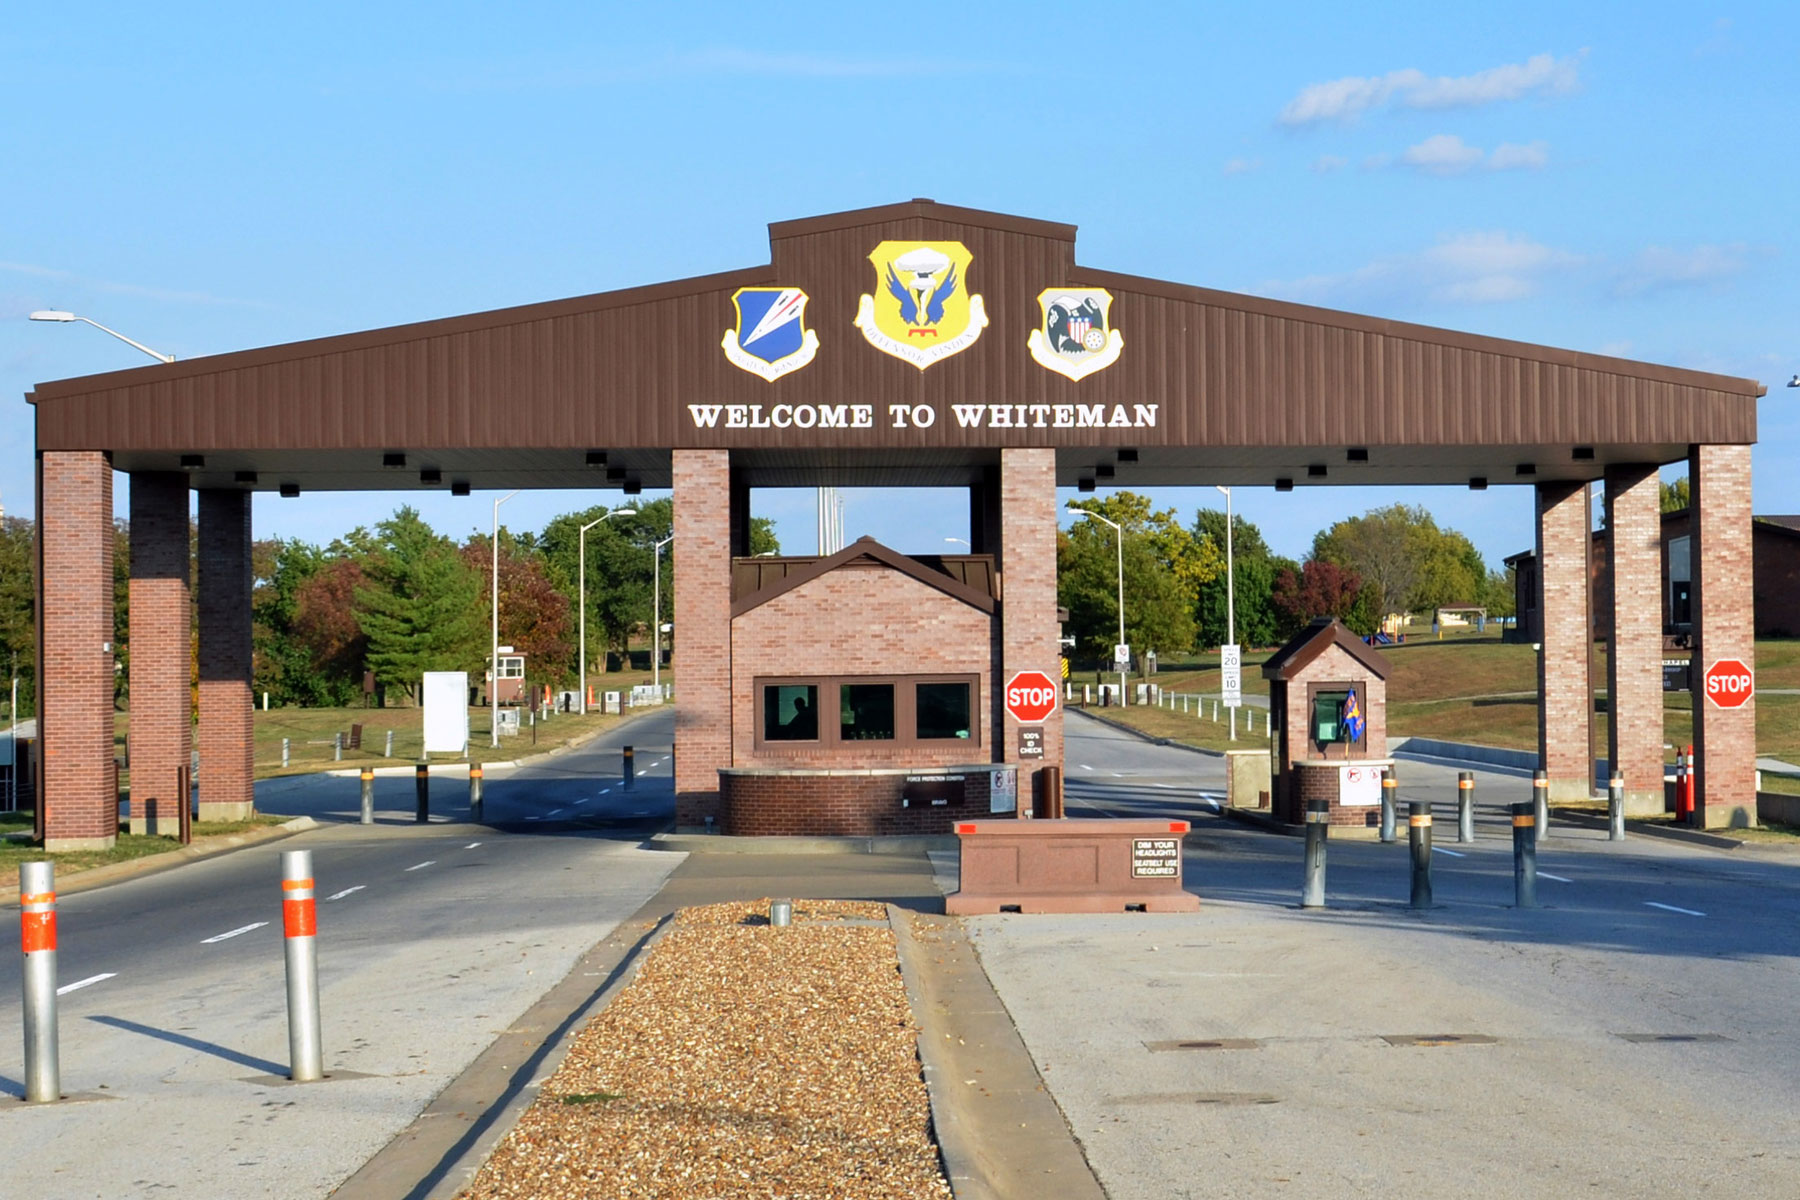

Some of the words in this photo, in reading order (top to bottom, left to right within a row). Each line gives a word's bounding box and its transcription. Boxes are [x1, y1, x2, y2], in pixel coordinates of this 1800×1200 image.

[687, 404, 873, 428] WELCOME
[889, 404, 936, 428] TO
[951, 404, 1159, 428] WHITEMAN
[1224, 657, 1238, 665] 20
[1226, 680, 1236, 688] 10
[1708, 675, 1751, 693] STOP
[1008, 687, 1054, 707] STOP
[1165, 859, 1177, 867] USE
